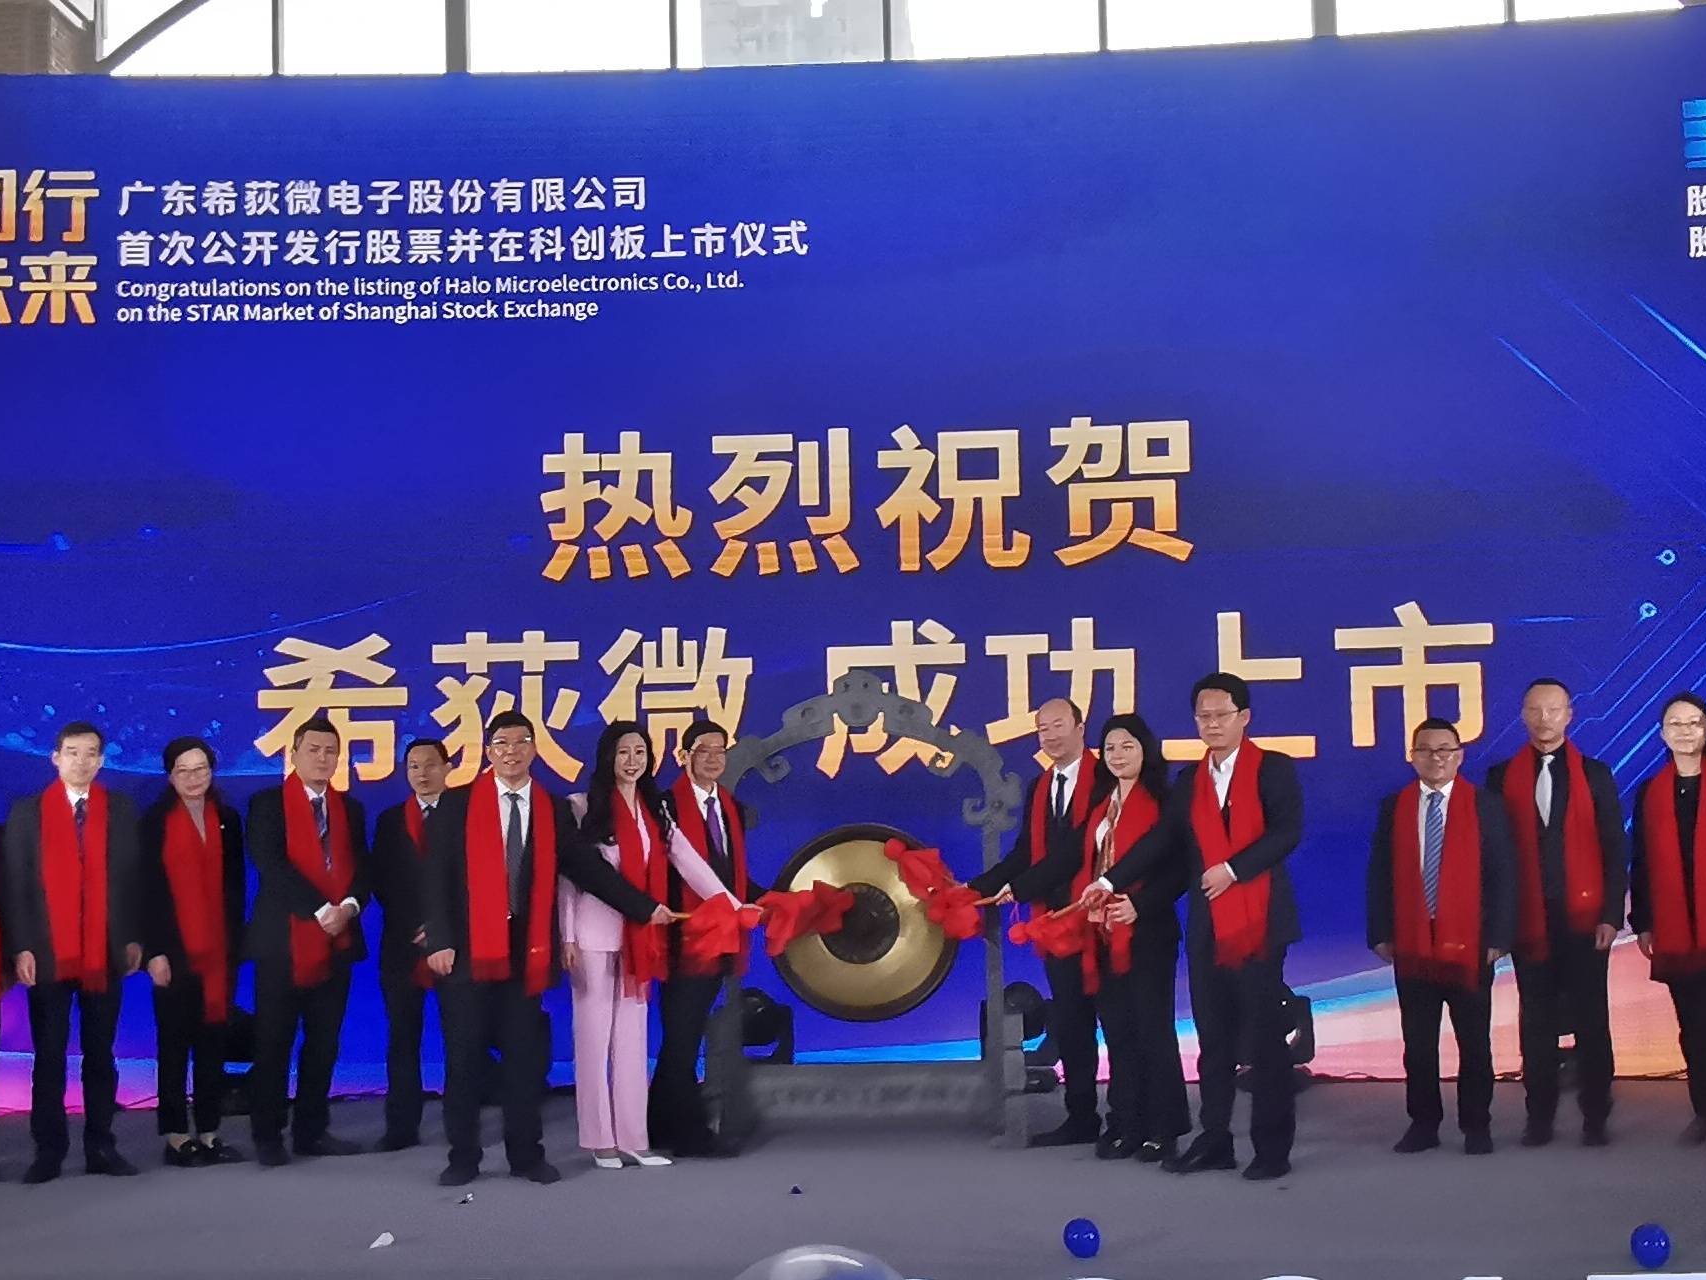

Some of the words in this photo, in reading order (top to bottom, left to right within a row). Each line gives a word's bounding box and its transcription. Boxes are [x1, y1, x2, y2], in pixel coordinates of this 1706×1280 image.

[118, 177, 646, 216] 广东希荻微电子股份有限公司
[116, 219, 809, 267] 首次公开发行股票并在科创板上市仪式
[117, 278, 281, 301] Congratulations
[285, 281, 311, 296] on
[316, 278, 349, 296] the
[354, 277, 417, 300] listing
[420, 277, 442, 295] of
[445, 276, 491, 294] Halo
[495, 273, 659, 294] Microelectronics
[663, 272, 702, 293] Co.,
[706, 271, 744, 289] Ltd.
[117, 306, 143, 322] on
[147, 304, 182, 322] the
[187, 304, 239, 322] STAR
[243, 303, 315, 321] Market
[319, 302, 341, 320] of
[343, 301, 438, 324] Shanghai
[441, 300, 499, 320] Stock
[504, 300, 598, 321] Exchange
[540, 416, 1194, 580] 热烈祝贺
[254, 625, 754, 791] 希荻微
[816, 601, 1494, 779] 成功上市
